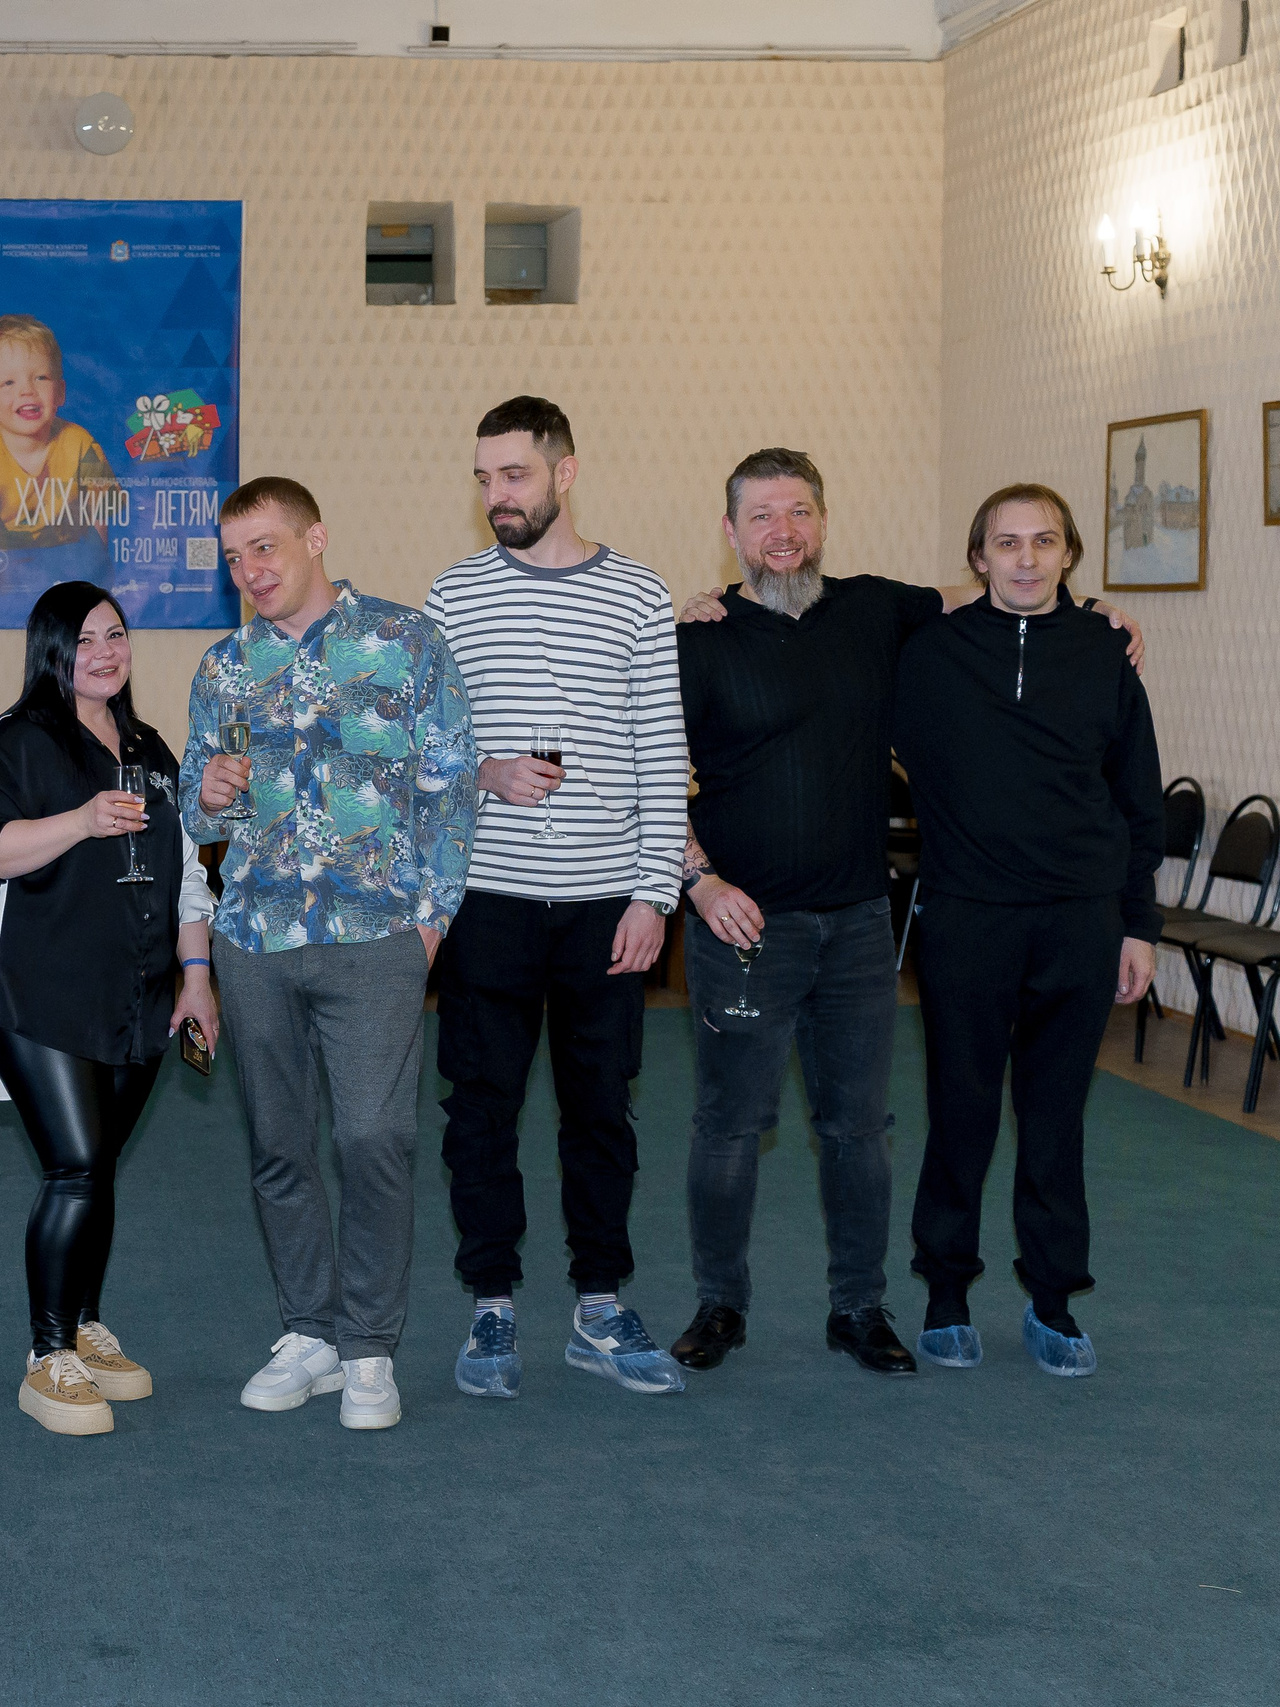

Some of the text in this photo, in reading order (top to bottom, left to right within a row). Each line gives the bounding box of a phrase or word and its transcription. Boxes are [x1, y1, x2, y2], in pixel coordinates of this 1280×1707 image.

[14, 477, 74, 527] XXIX
[79, 489, 130, 527] КИНО
[152, 489, 219, 530] ДЕТЯМ
[113, 537, 178, 563] 16-20 МАЯ
